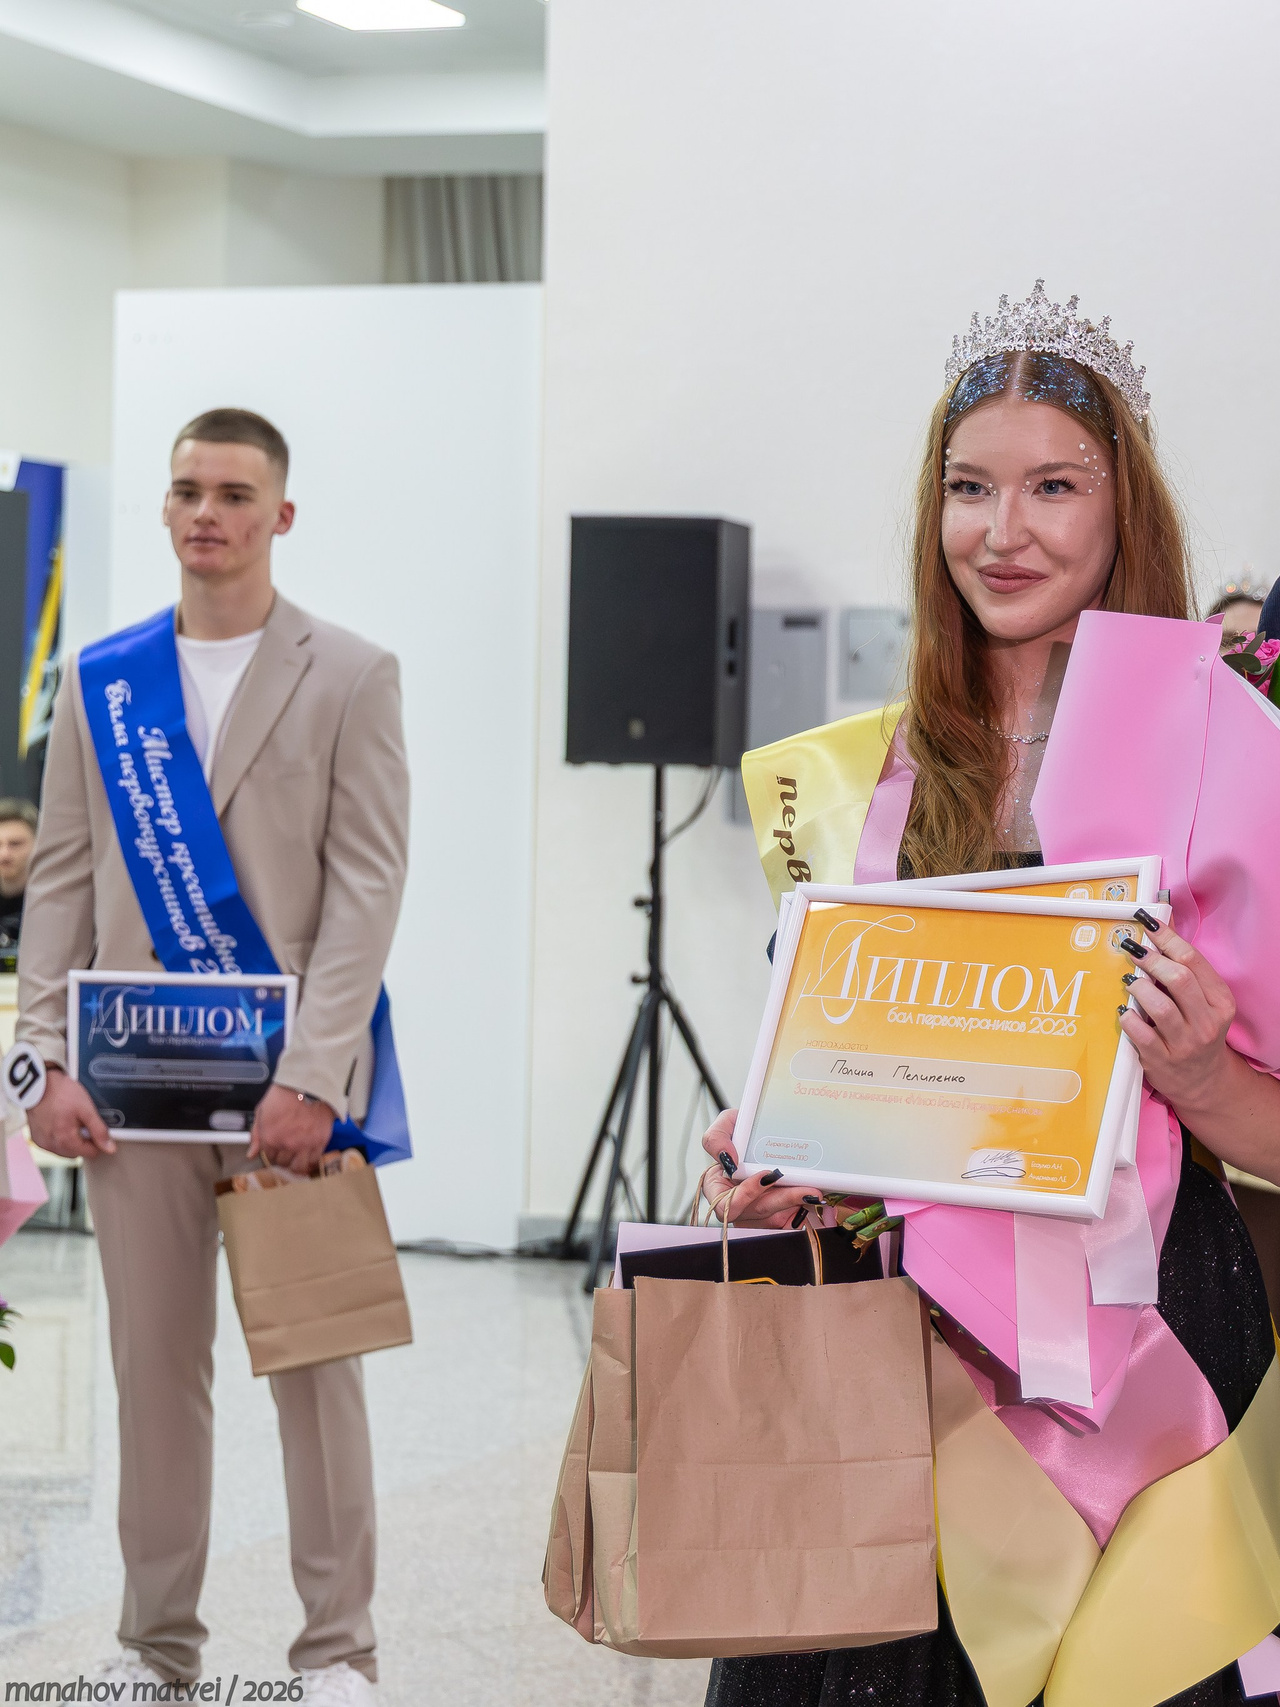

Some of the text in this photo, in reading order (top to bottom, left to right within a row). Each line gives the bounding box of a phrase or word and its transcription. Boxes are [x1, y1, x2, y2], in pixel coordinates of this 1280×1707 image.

[104, 678, 132, 748] Бала
[137, 725, 183, 836] Мистер
[117, 751, 208, 952] первокурсников
[790, 914, 1092, 1025] ДИПЛОМ
[87, 985, 265, 1048] ДИПЛОМ
[886, 1006, 914, 1024] бал
[1027, 1016, 1078, 1037] 2026
[830, 1059, 967, 1084] Полина Пелипенко
